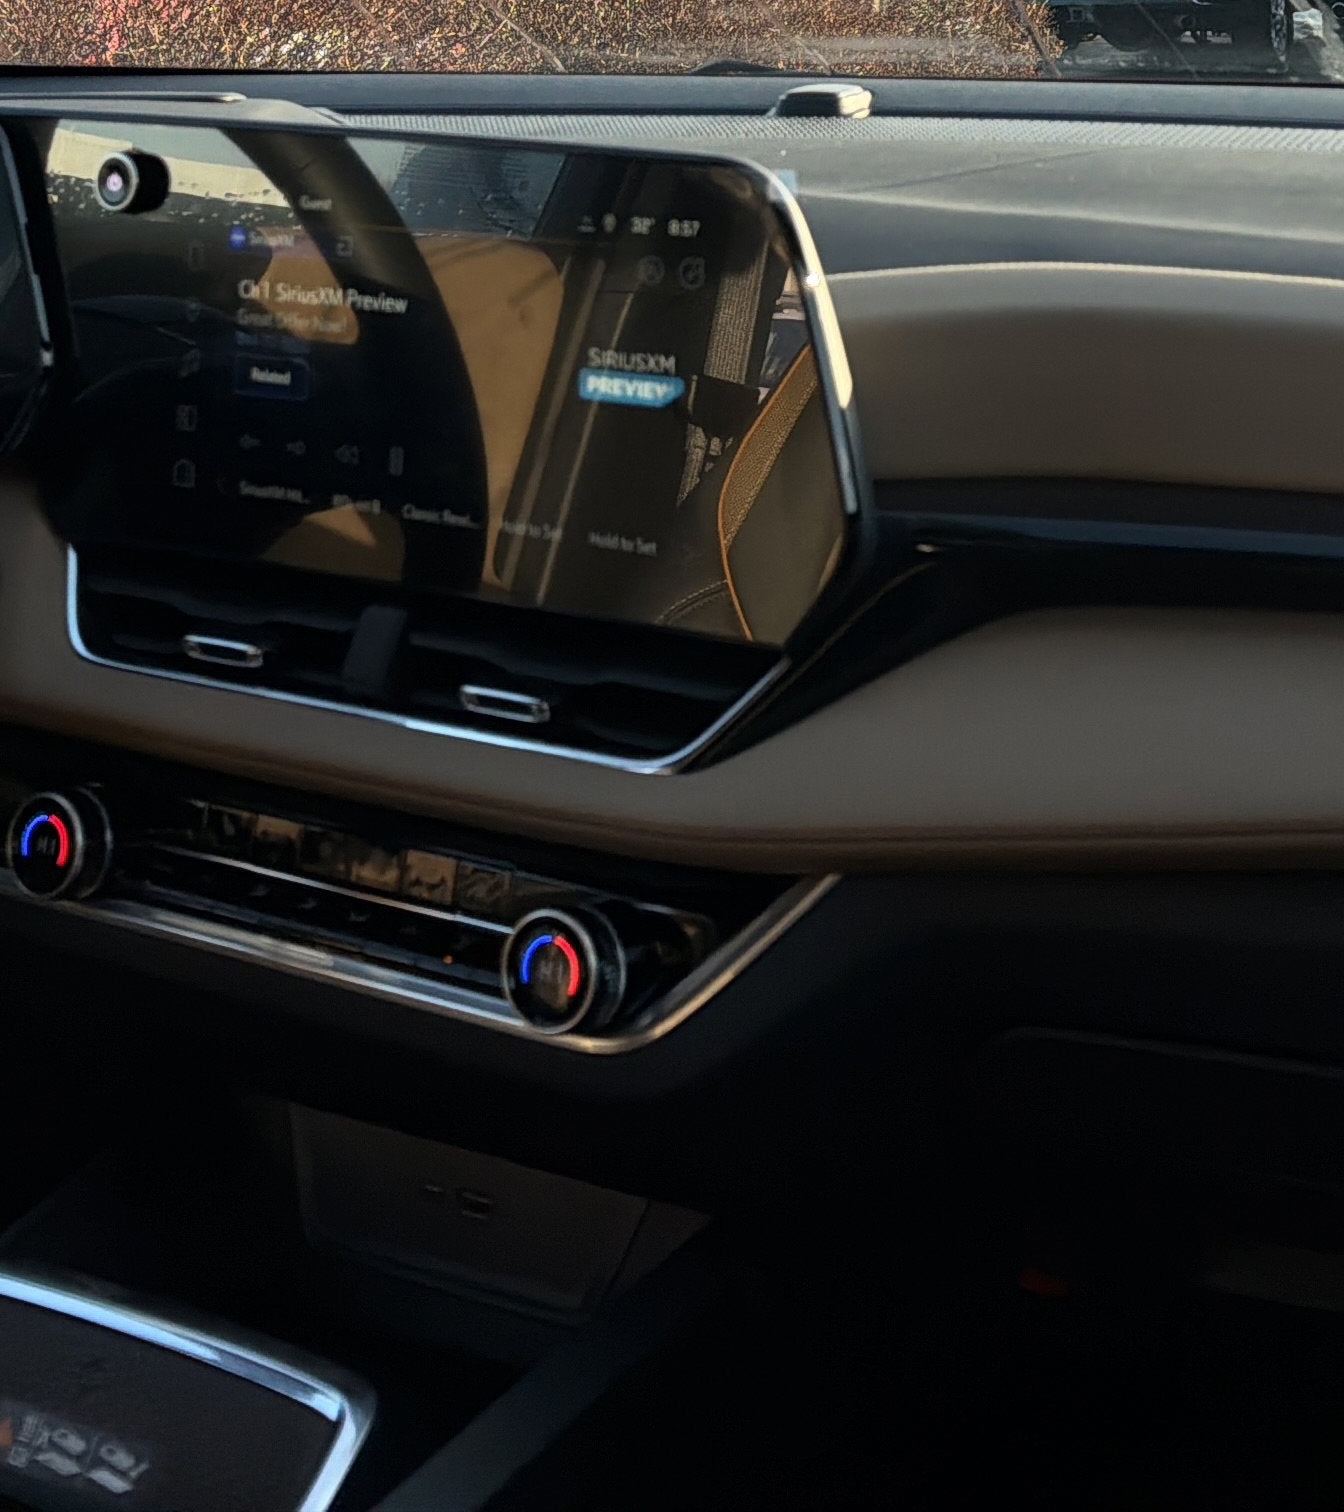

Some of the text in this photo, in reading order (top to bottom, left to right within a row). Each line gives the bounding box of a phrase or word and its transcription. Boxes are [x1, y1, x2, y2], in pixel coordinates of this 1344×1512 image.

[275, 281, 344, 306] SiriusXM
[346, 287, 408, 314] Preview
[587, 347, 676, 375] SIRIUSXM
